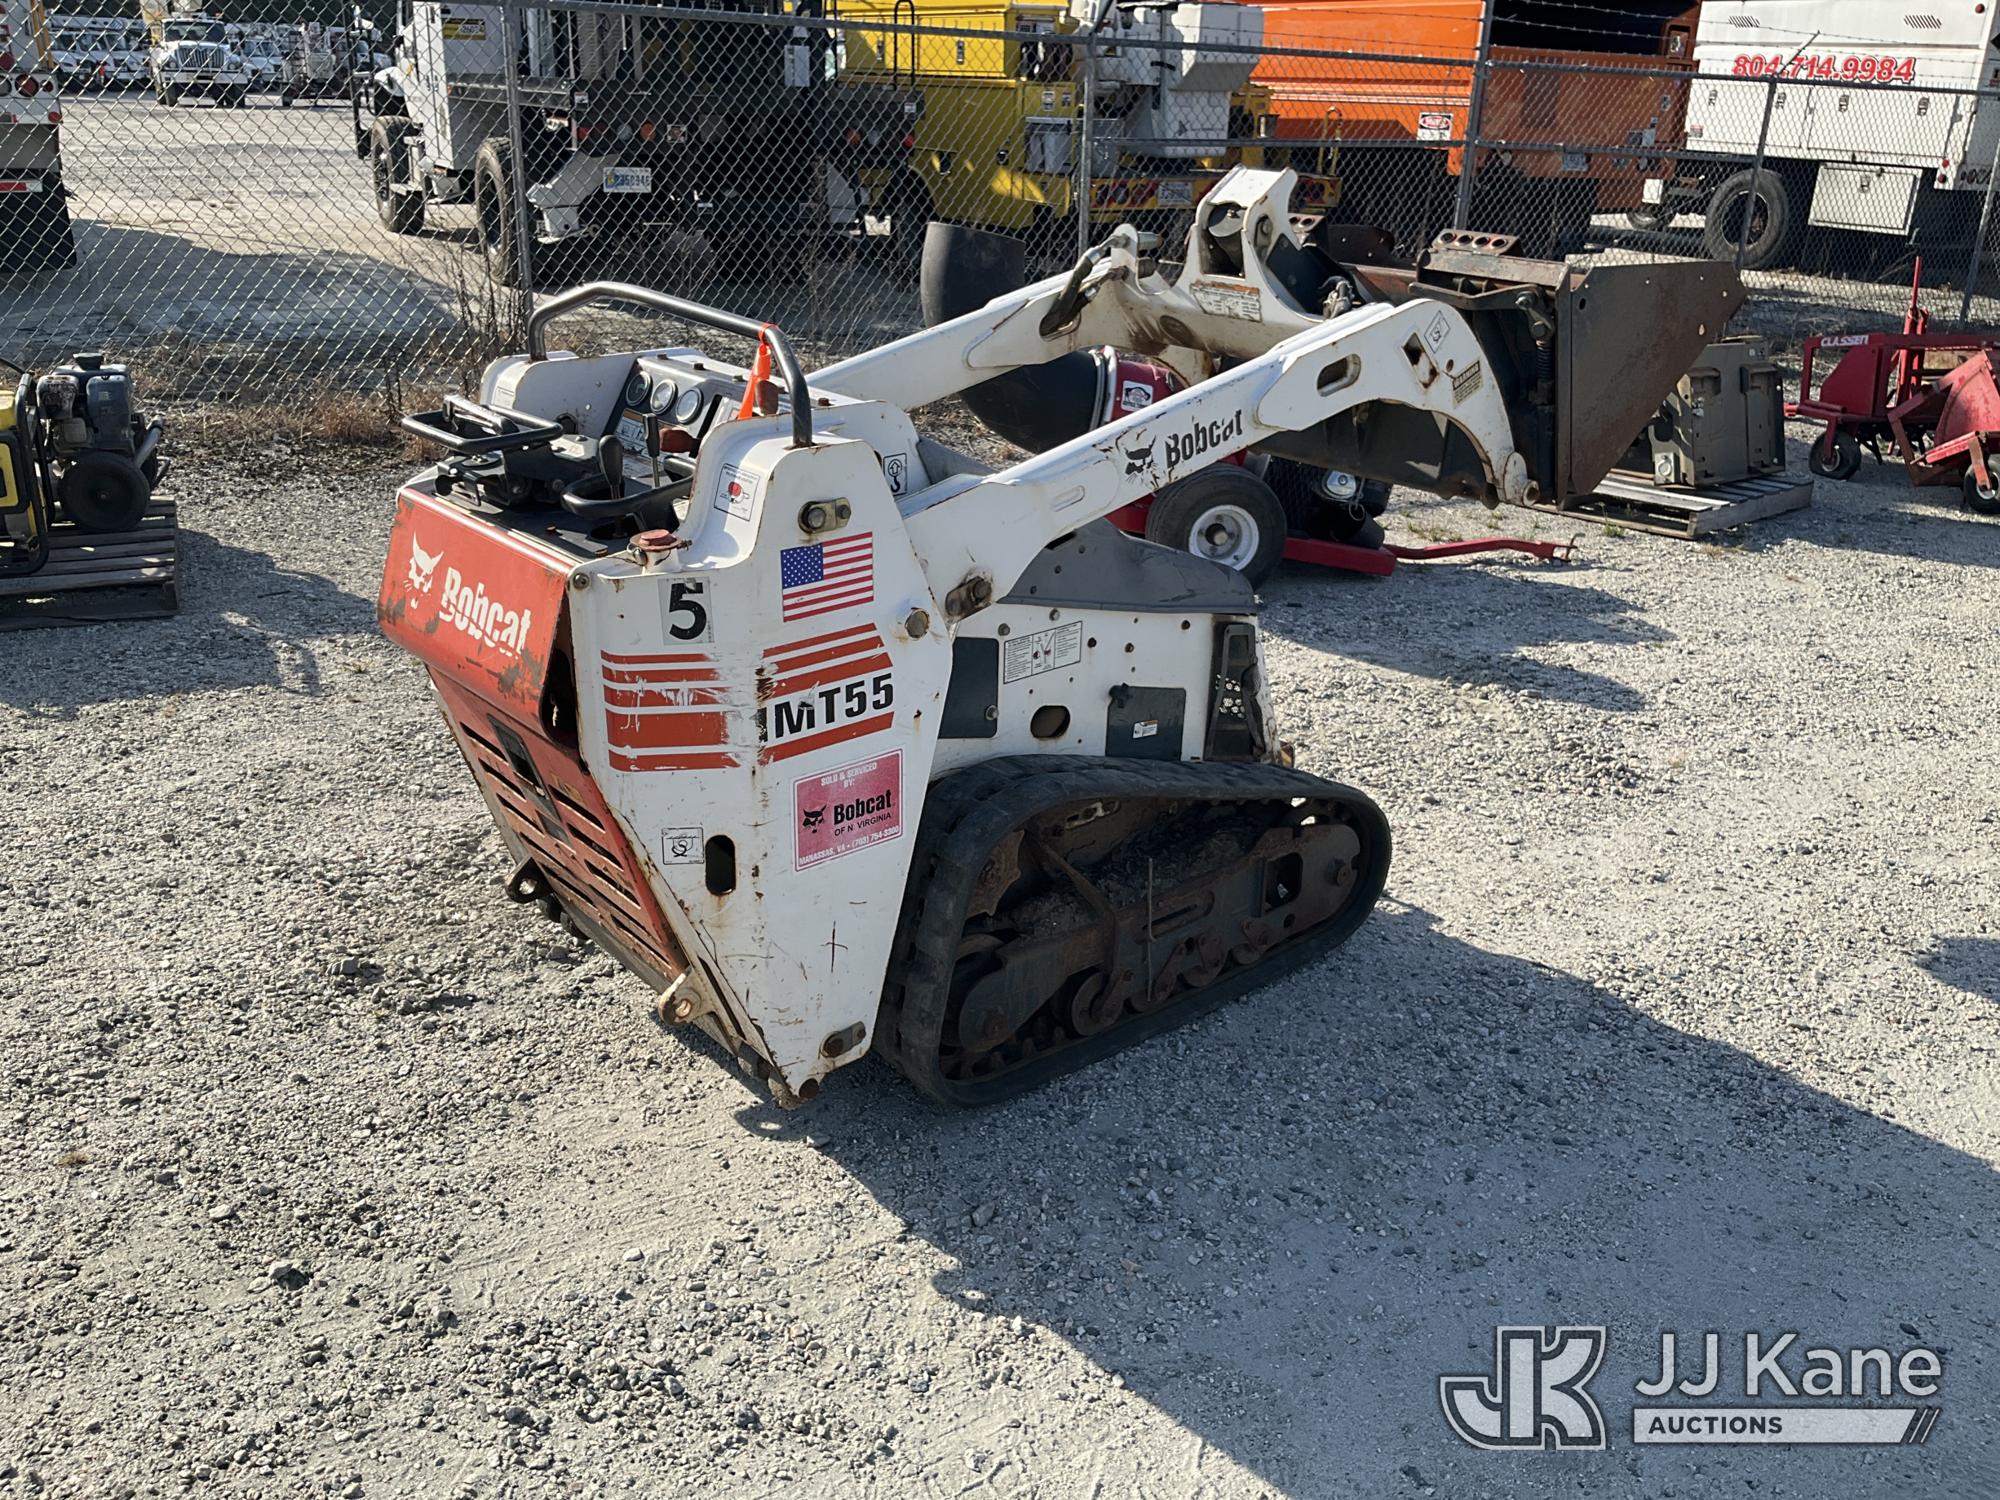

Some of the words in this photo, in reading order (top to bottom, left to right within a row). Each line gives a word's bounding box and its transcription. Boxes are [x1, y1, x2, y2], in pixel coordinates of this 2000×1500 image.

[1732, 53, 1916, 83] 804.714.9984
[1821, 334, 1870, 347] CLASSEN
[1165, 409, 1243, 469] Bobcat
[439, 566, 532, 660] Bobcat
[669, 582, 707, 640] 5
[774, 672, 894, 739] MT55
[821, 773, 838, 786] SOLD
[847, 762, 877, 778] SERVICED
[833, 789, 892, 825] Bobcat
[834, 827, 846, 837] OF
[857, 812, 892, 829] VIRGINIA
[837, 844, 846, 853] VA
